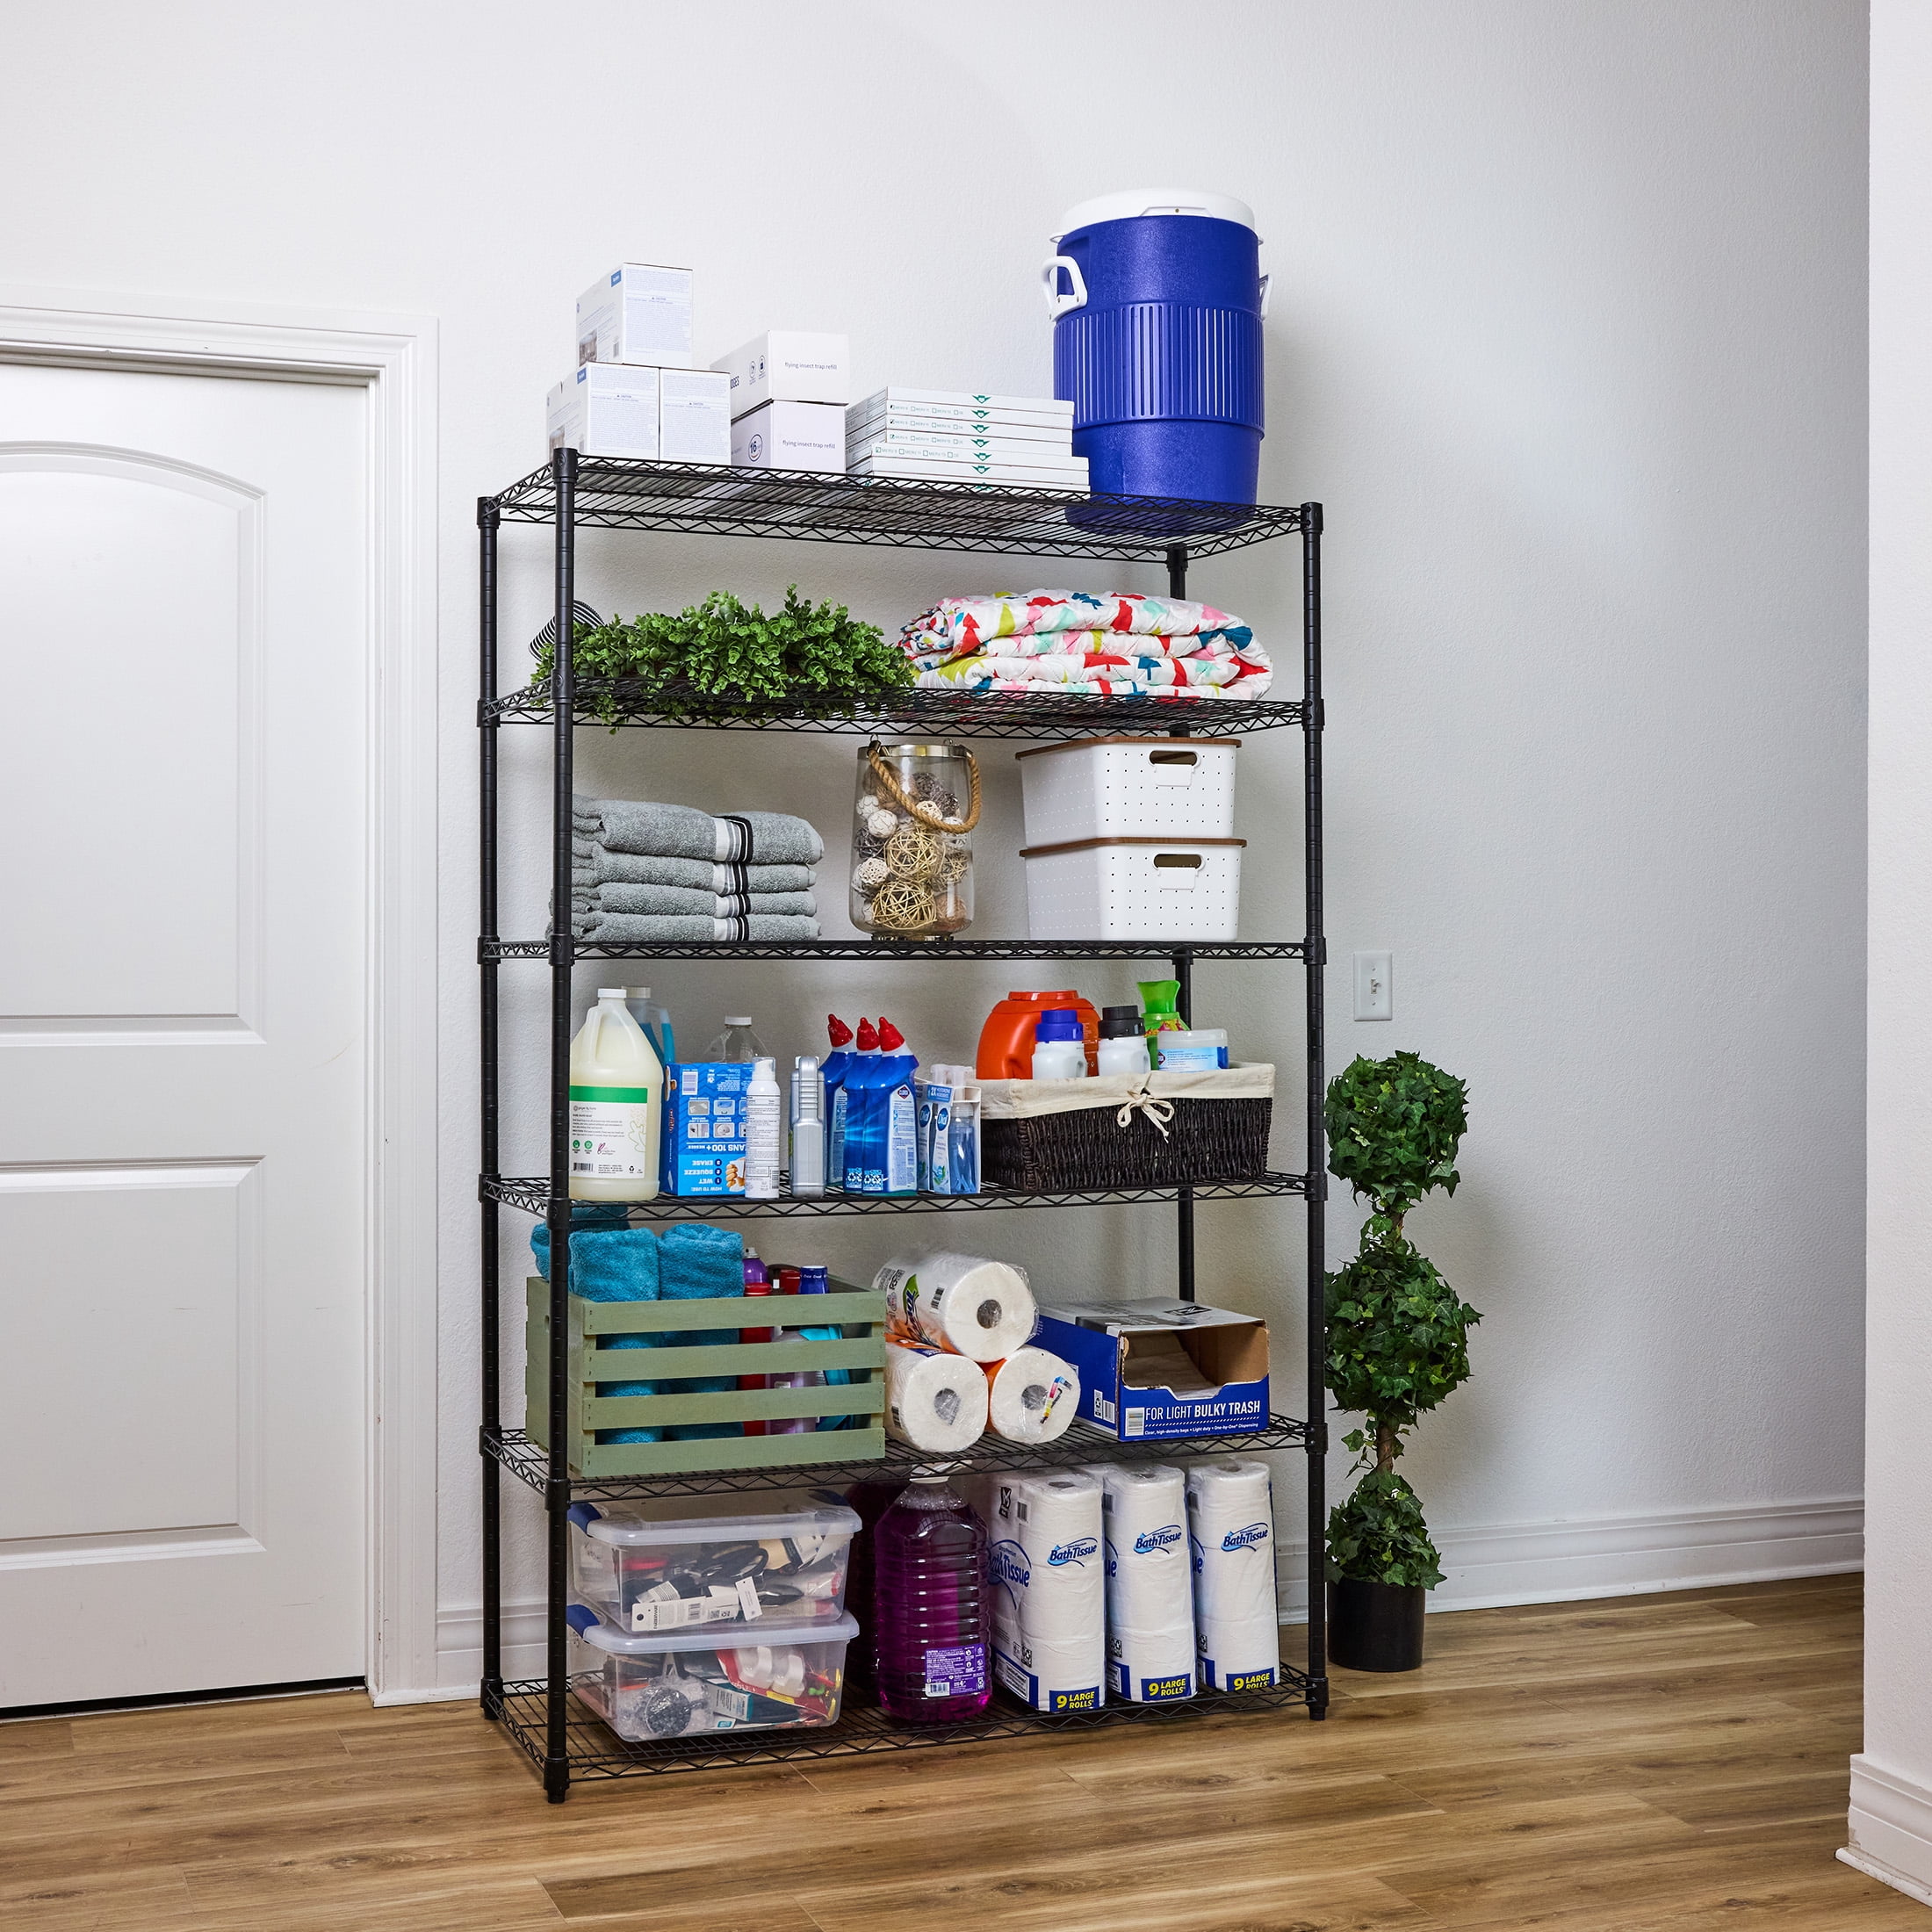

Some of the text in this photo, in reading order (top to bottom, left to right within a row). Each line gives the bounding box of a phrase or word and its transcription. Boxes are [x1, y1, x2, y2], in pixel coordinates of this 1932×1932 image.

[750, 441, 757, 454] 16
[919, 1109, 930, 1121] Dial
[937, 1113, 948, 1125] Dial
[1145, 1400, 1260, 1421] FOR LIGHT BULKY TRASH
[1135, 1532, 1182, 1549] BathTissue
[1223, 1529, 1268, 1547] BathTissue
[1049, 1545, 1098, 1561] BathTissue
[1148, 1678, 1186, 1697] 9 LARGE
[1233, 1672, 1271, 1690] 9 LARGE
[1056, 1690, 1095, 1709] 9 LARGE
[1160, 1686, 1185, 1697] ROLLS
[1069, 1700, 1092, 1710] ROLLS
